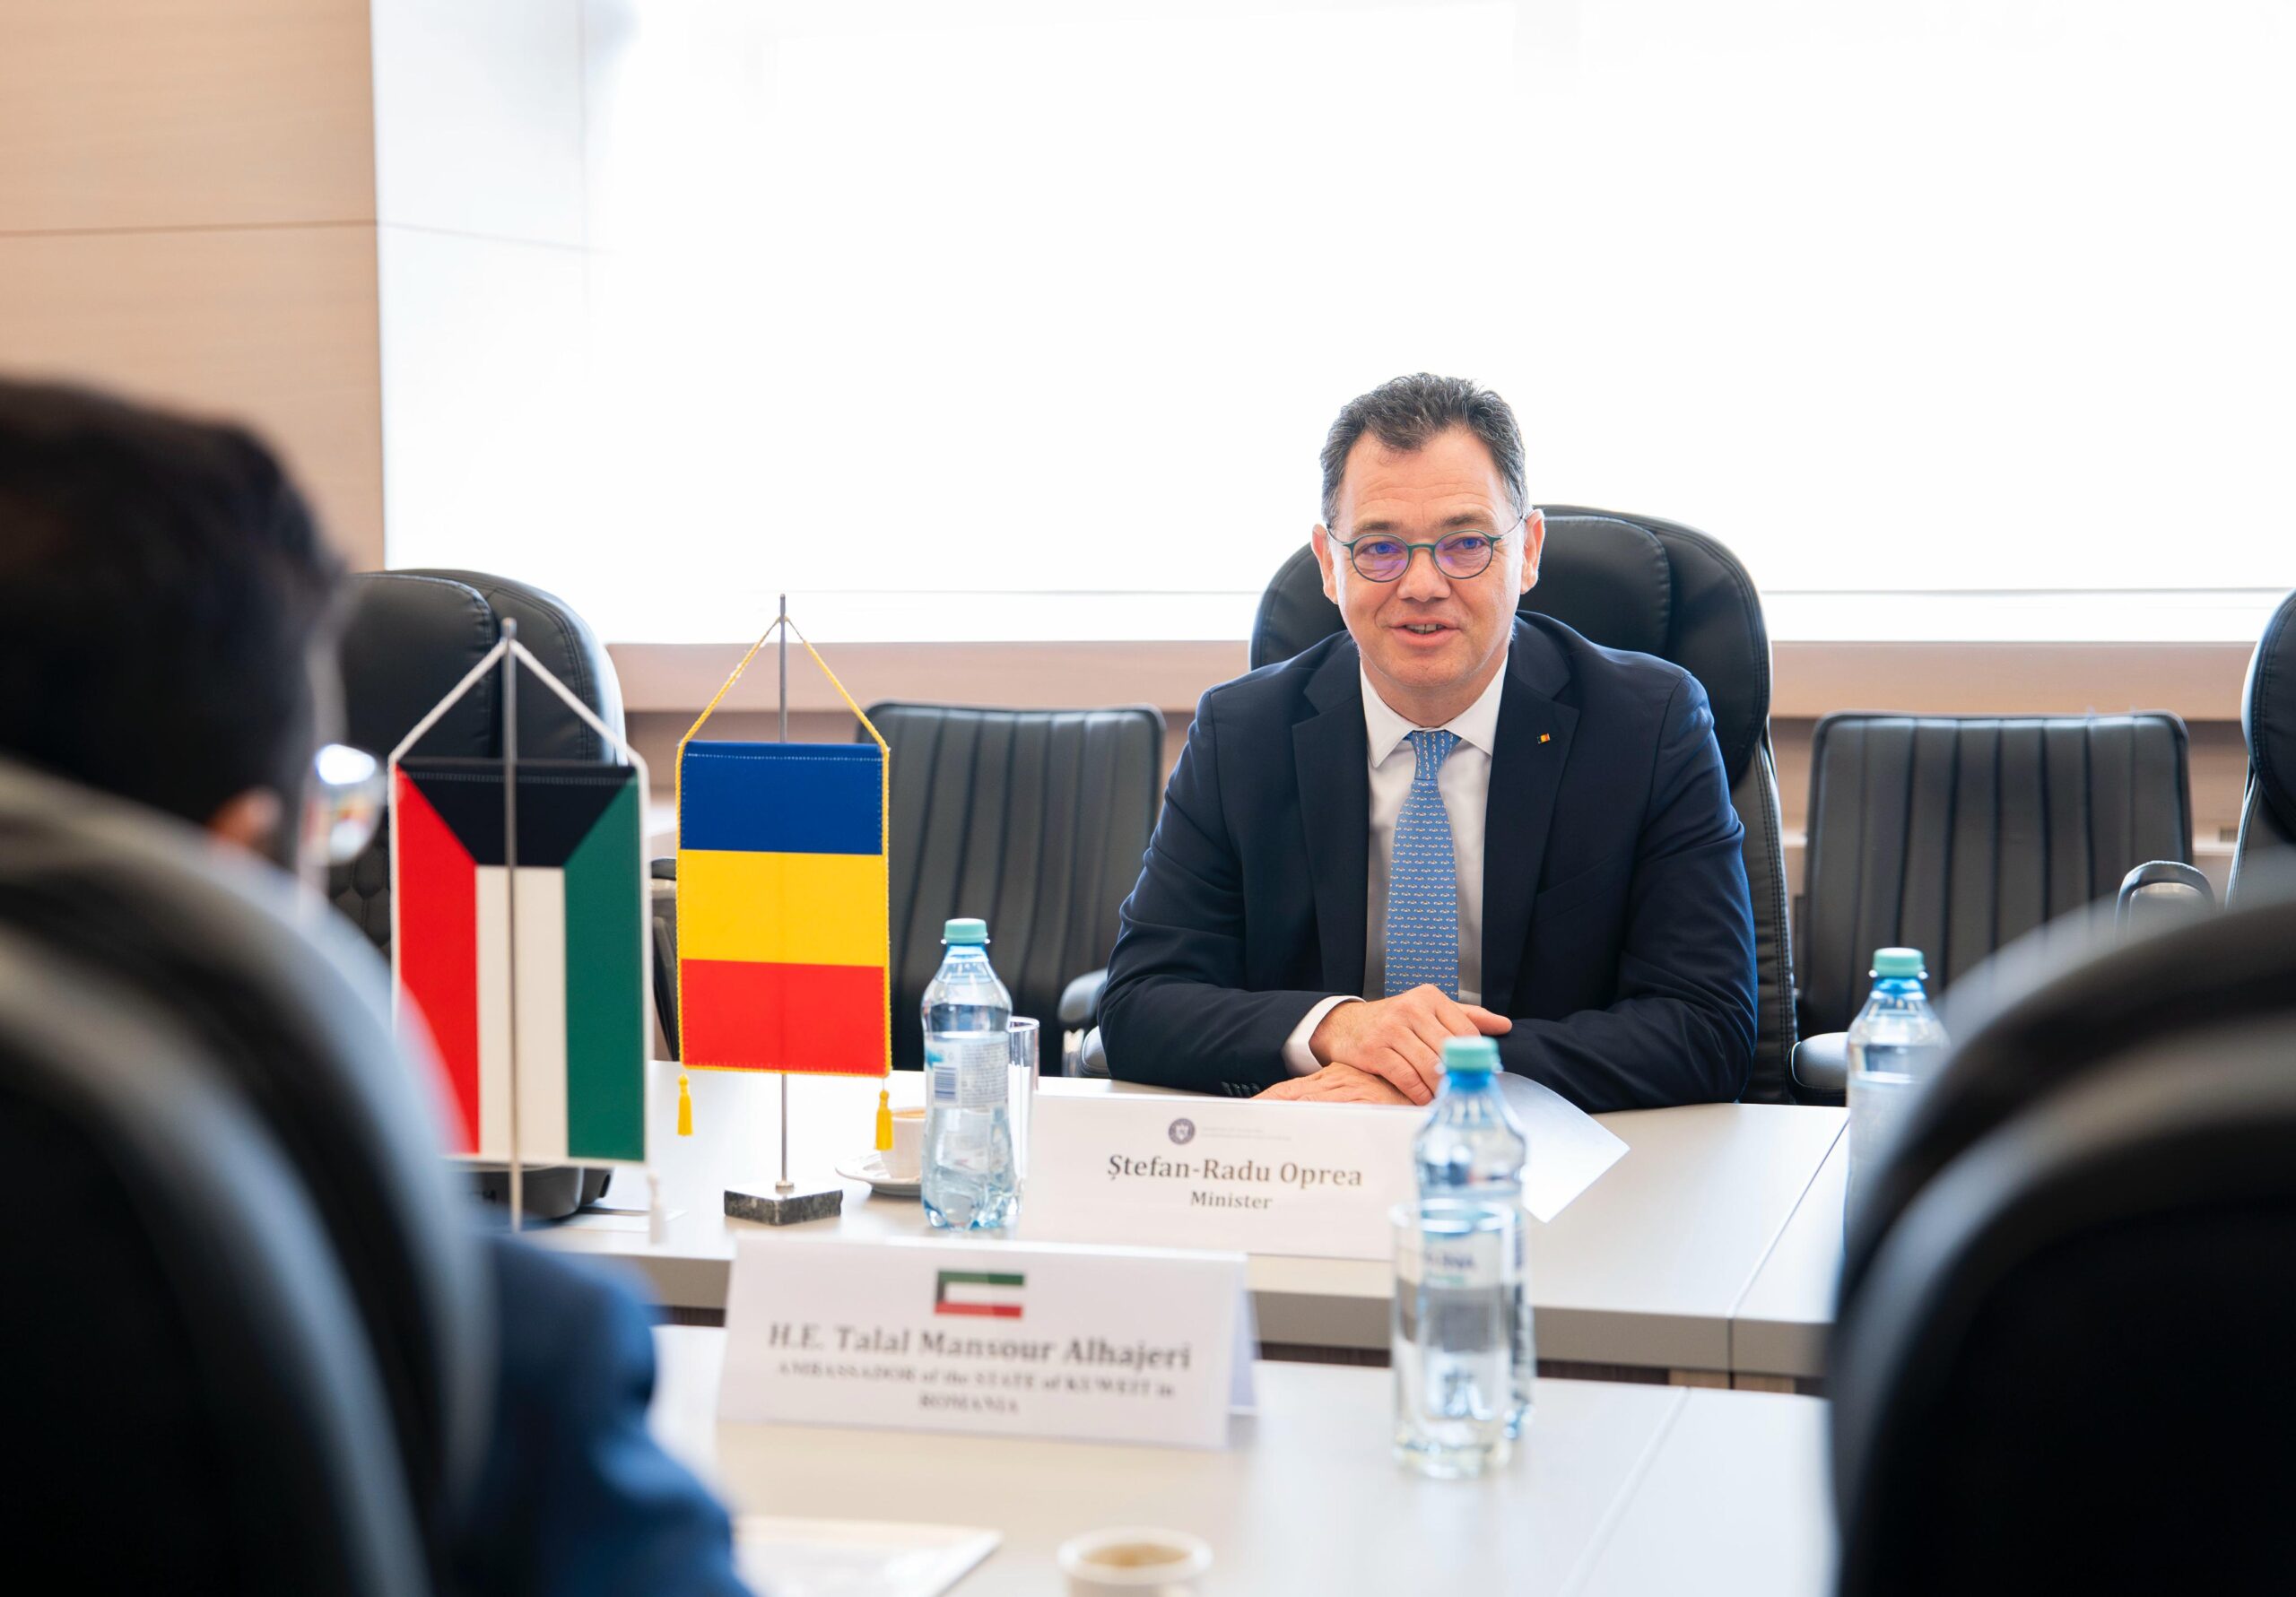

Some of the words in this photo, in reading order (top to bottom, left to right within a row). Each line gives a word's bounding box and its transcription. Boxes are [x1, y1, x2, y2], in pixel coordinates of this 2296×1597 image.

[1108, 1154, 1271, 1182] Ștefan-Radu
[1280, 1161, 1362, 1189] Oprea
[1190, 1191, 1273, 1210] Minister
[769, 1323, 823, 1350] H.E.
[835, 1325, 911, 1353] Talal
[919, 1329, 1056, 1361] Mansour
[1065, 1337, 1191, 1373] Alhajeri
[778, 1360, 917, 1382] AMBASSADOR
